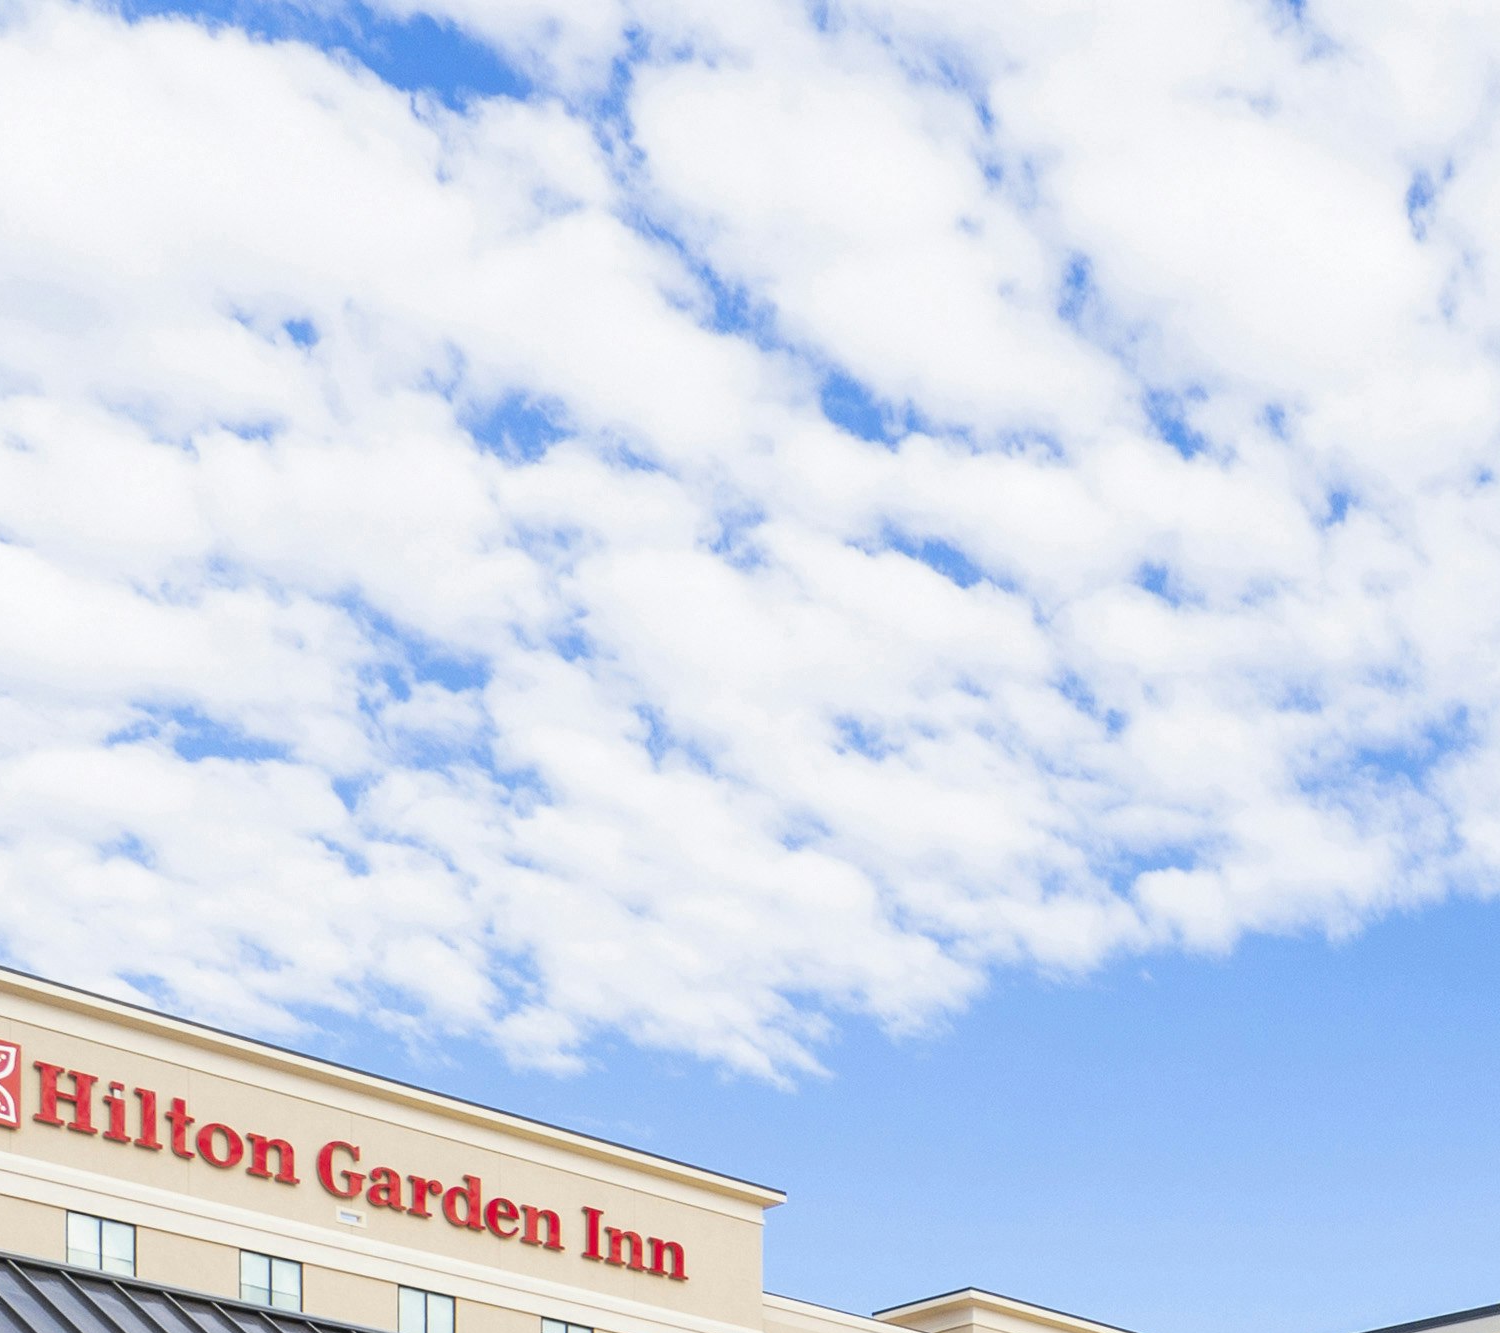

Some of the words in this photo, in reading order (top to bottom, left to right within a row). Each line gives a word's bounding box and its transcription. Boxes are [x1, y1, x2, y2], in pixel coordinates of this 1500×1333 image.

[33, 1060, 300, 1185] Hilton
[316, 1140, 566, 1251] Garden
[581, 1206, 689, 1281] Inn
